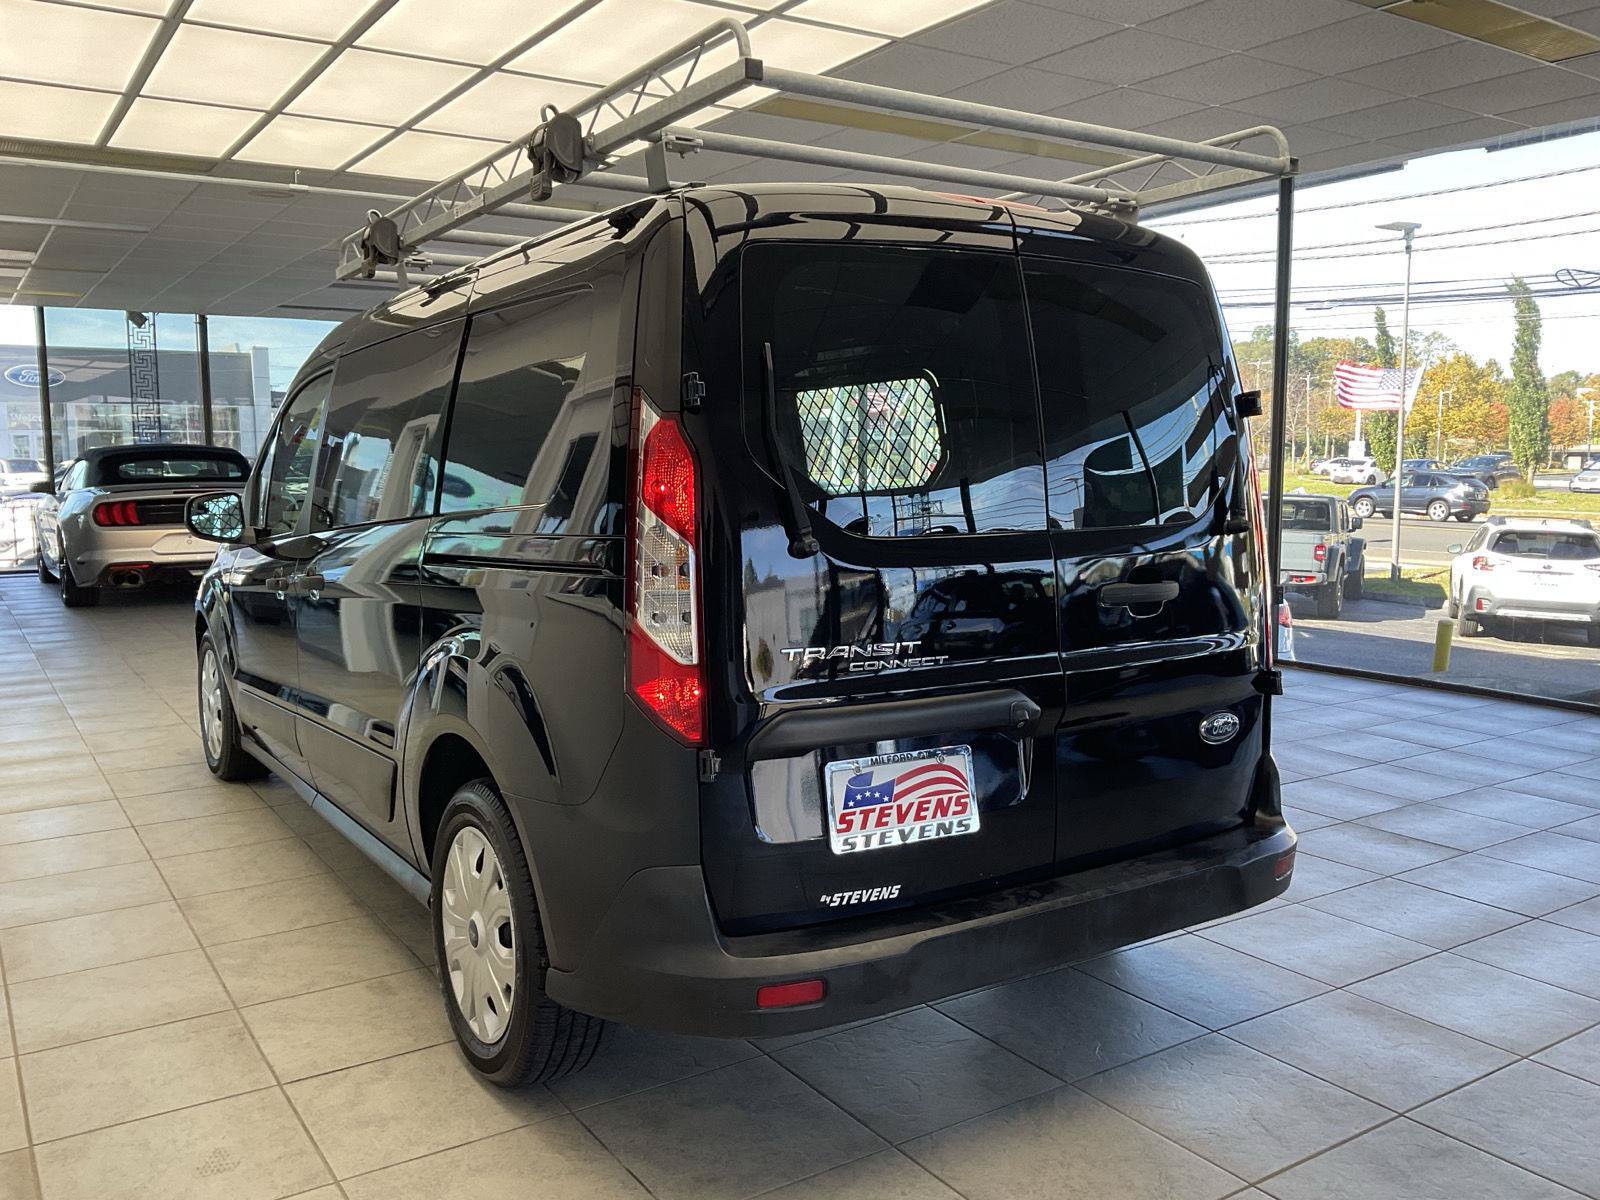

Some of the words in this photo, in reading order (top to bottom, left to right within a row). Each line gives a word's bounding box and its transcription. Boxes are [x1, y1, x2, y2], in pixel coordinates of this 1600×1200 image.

[781, 640, 922, 662] TRANSIT
[850, 655, 949, 672] CONNECT
[1212, 715, 1233, 735] Ford
[870, 752, 913, 766] MILFORD
[837, 794, 970, 834] STEVENS
[841, 817, 972, 853] STEVENS
[829, 884, 902, 907] STEVENS
